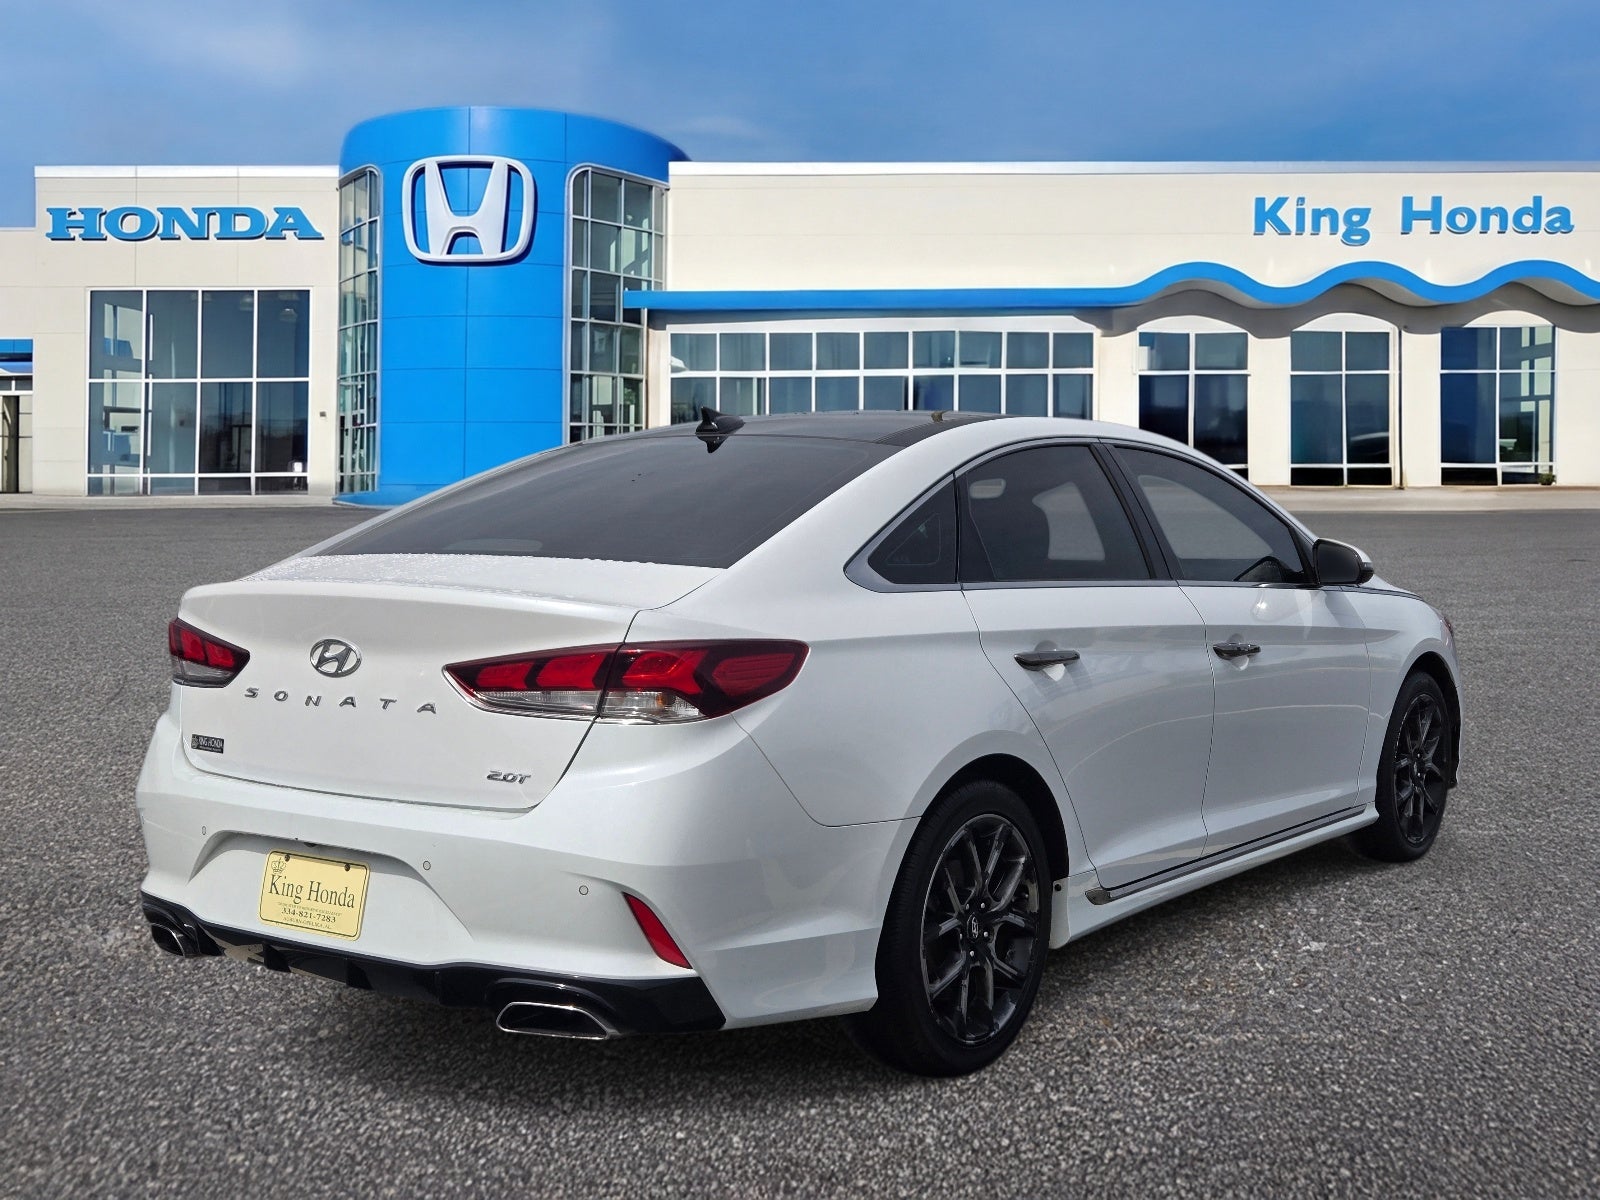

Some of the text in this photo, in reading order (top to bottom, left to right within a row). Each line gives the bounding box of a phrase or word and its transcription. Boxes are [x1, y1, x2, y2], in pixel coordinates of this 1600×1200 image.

[46, 206, 325, 241] HONDA
[1253, 195, 1575, 247] King Honda
[244, 687, 437, 715] SONATA
[268, 873, 304, 905] King
[306, 880, 355, 909] Honda
[281, 907, 337, 923] 334-821-7283
